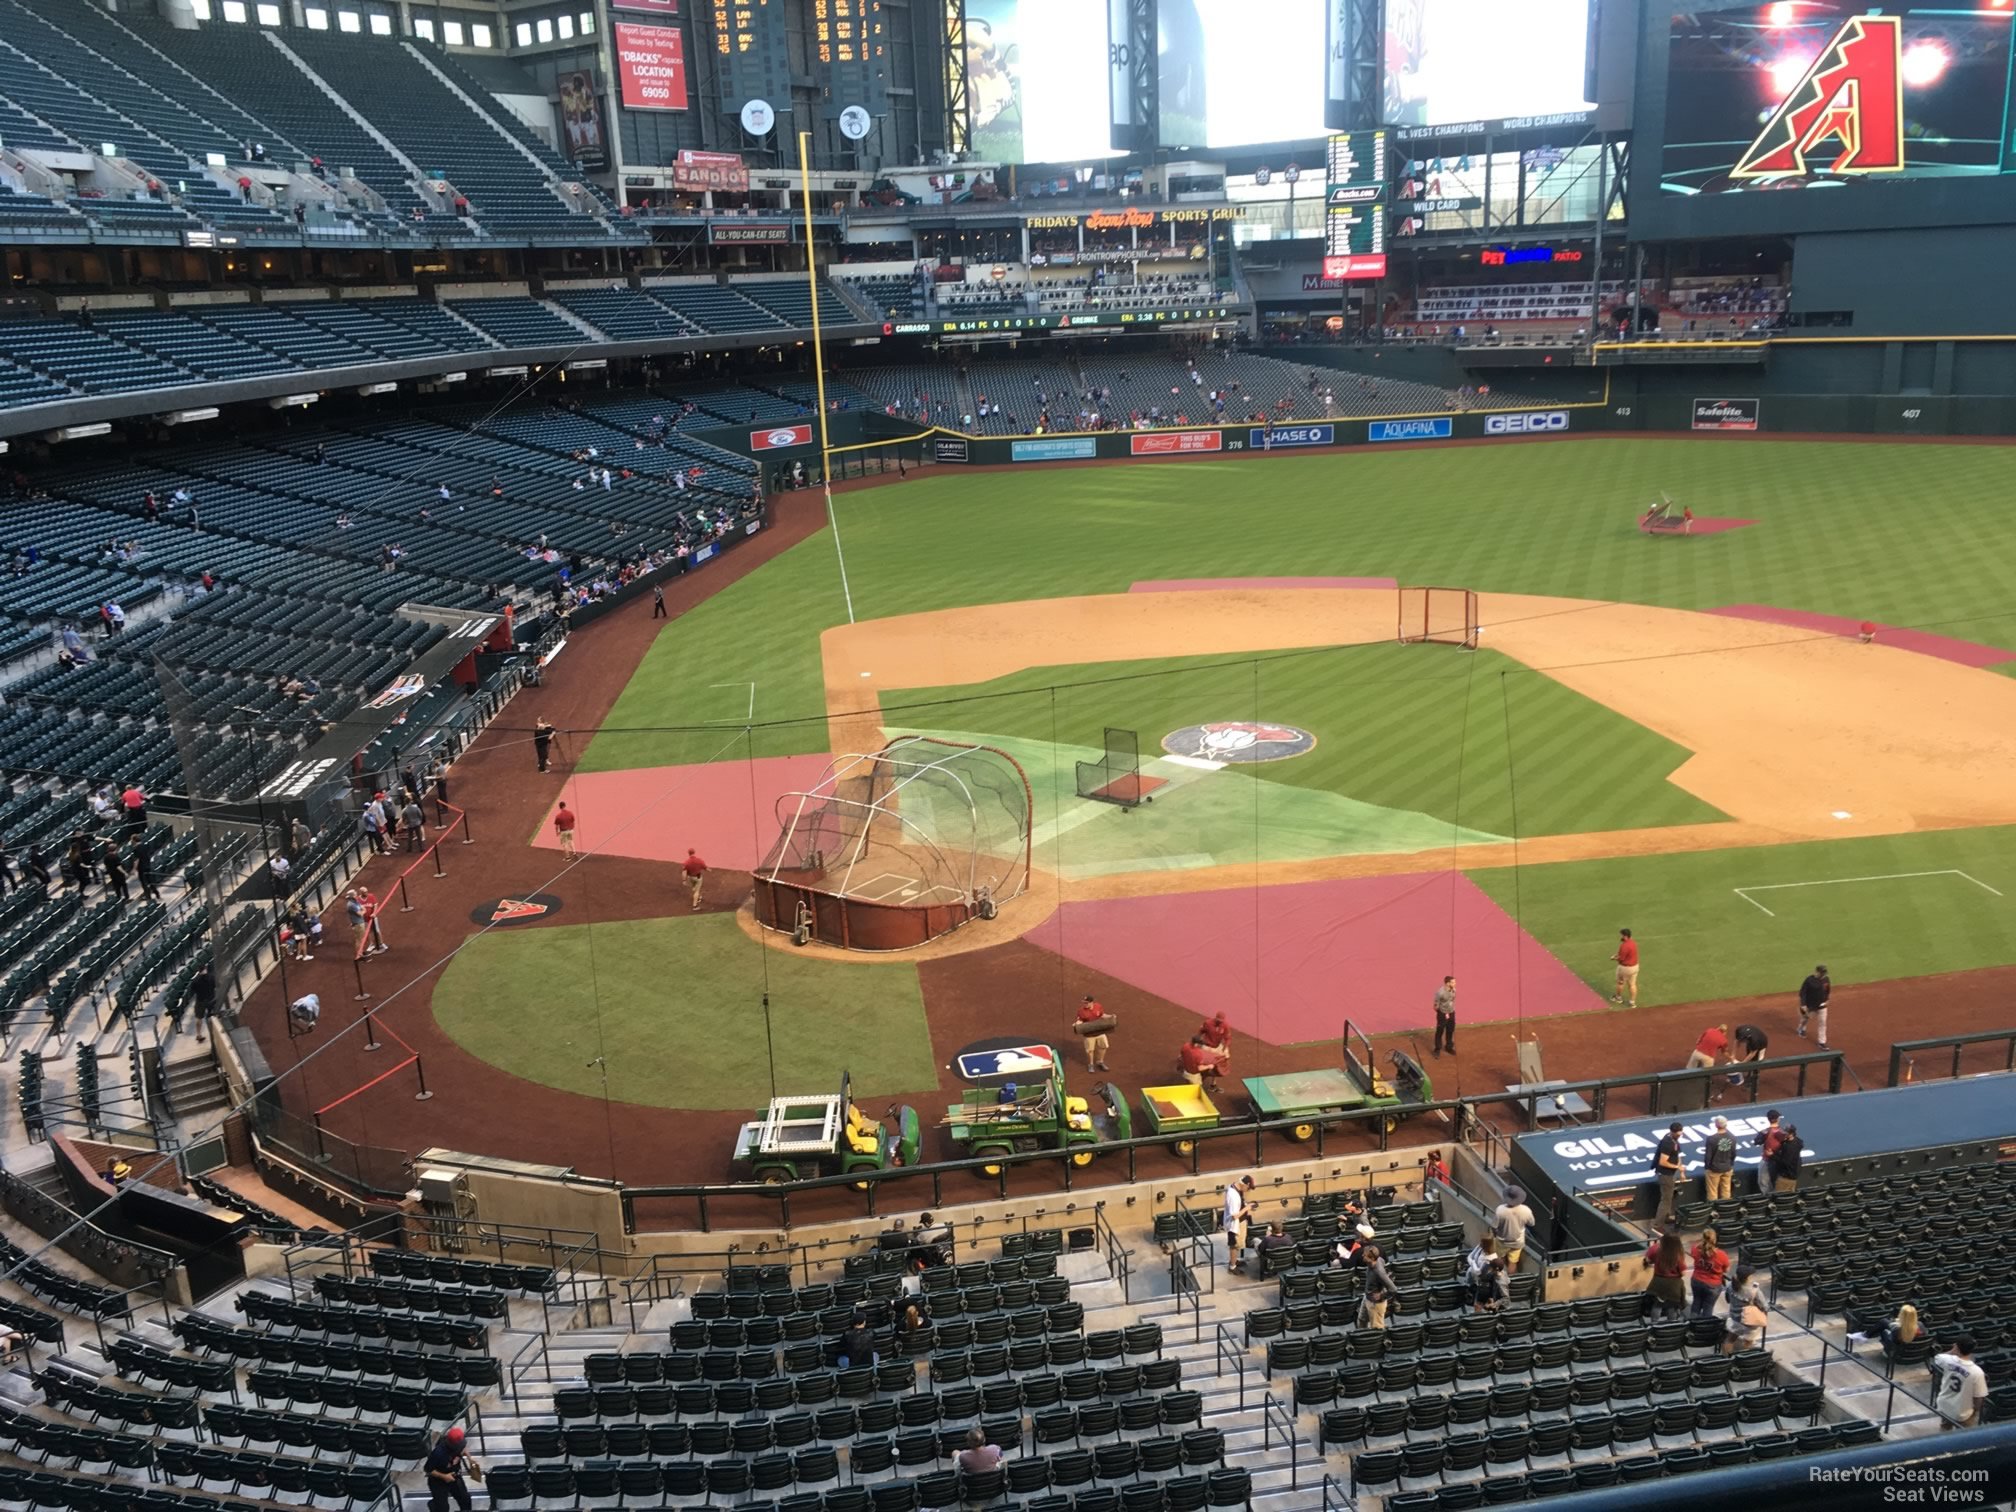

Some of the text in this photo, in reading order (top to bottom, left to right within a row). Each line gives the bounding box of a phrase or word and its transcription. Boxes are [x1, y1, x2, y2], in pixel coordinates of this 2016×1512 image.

[620, 25, 680, 38] Report Guest Conduct
[874, 24, 881, 34] 2
[646, 39, 654, 47] by
[876, 46, 883, 56] 2
[633, 64, 674, 78] LOCATION
[641, 87, 670, 99] 69050
[1503, 112, 1587, 129] WORLD CHAMPIONS
[1410, 126, 1433, 138] WEST
[1434, 122, 1485, 136] CHAMPIONS
[1413, 200, 1460, 212] WILD CARD
[1027, 216, 1078, 228] FRIDAYS
[1161, 211, 1208, 222] SPORTS
[1212, 208, 1247, 220] GRILL
[715, 230, 786, 240] ALL-YOU-CAN-EAT SEATS
[1554, 252, 1582, 261] PATIO
[1121, 314, 1135, 322] ERA
[1155, 312, 1165, 320] PC
[1195, 310, 1202, 318] 0
[1220, 309, 1226, 317] 0
[944, 323, 957, 331] ERA
[978, 321, 988, 329] PC
[993, 320, 999, 328] 0
[1015, 319, 1022, 327] 0
[1040, 318, 1047, 326] 0
[1616, 407, 1631, 416] 413
[1696, 407, 1743, 416] Safelite
[1902, 409, 1921, 419] 407
[1486, 413, 1567, 433] GEICO
[1383, 421, 1437, 438] AQUAFINA
[1263, 430, 1308, 442] HASE
[1553, 1132, 1658, 1158] GILA
[1949, 1375, 1962, 1393] 3
